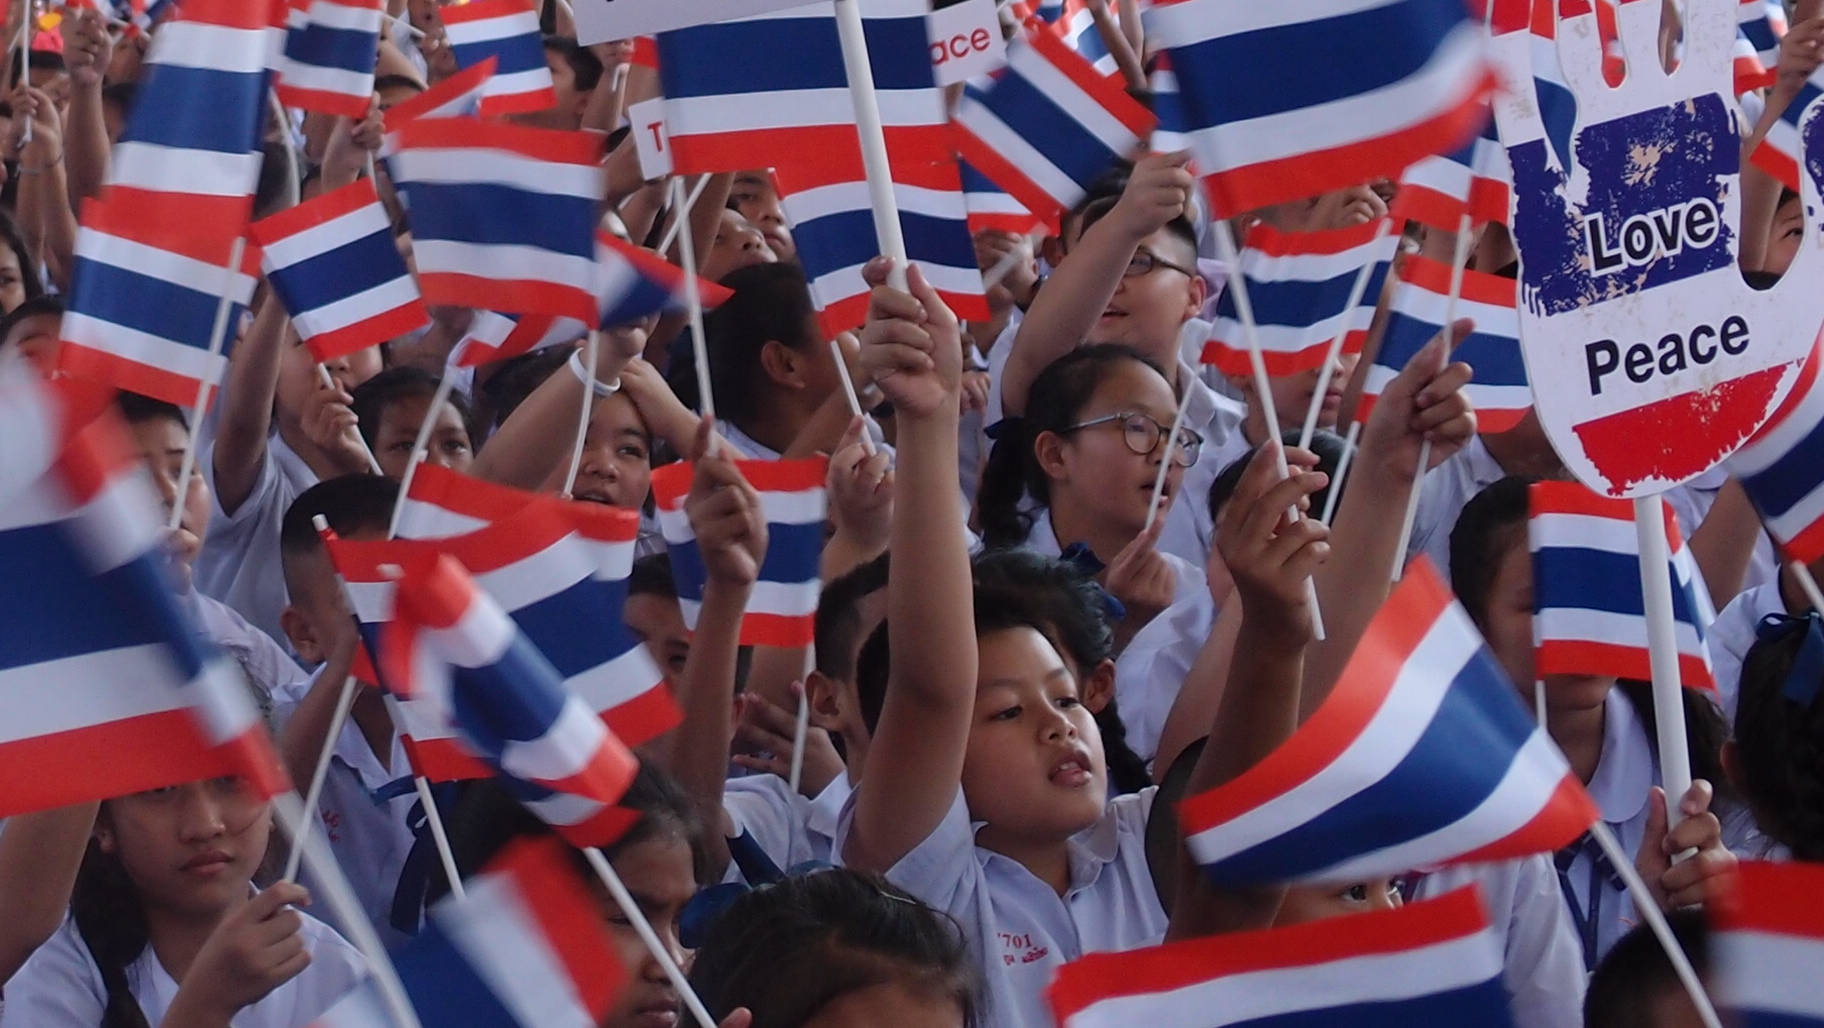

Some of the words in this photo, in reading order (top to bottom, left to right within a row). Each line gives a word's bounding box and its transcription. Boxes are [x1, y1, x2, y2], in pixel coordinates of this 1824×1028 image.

[928, 28, 991, 66] ace
[1586, 199, 1718, 275] Love
[1585, 315, 1750, 396] Peace
[997, 933, 1032, 949] 701
